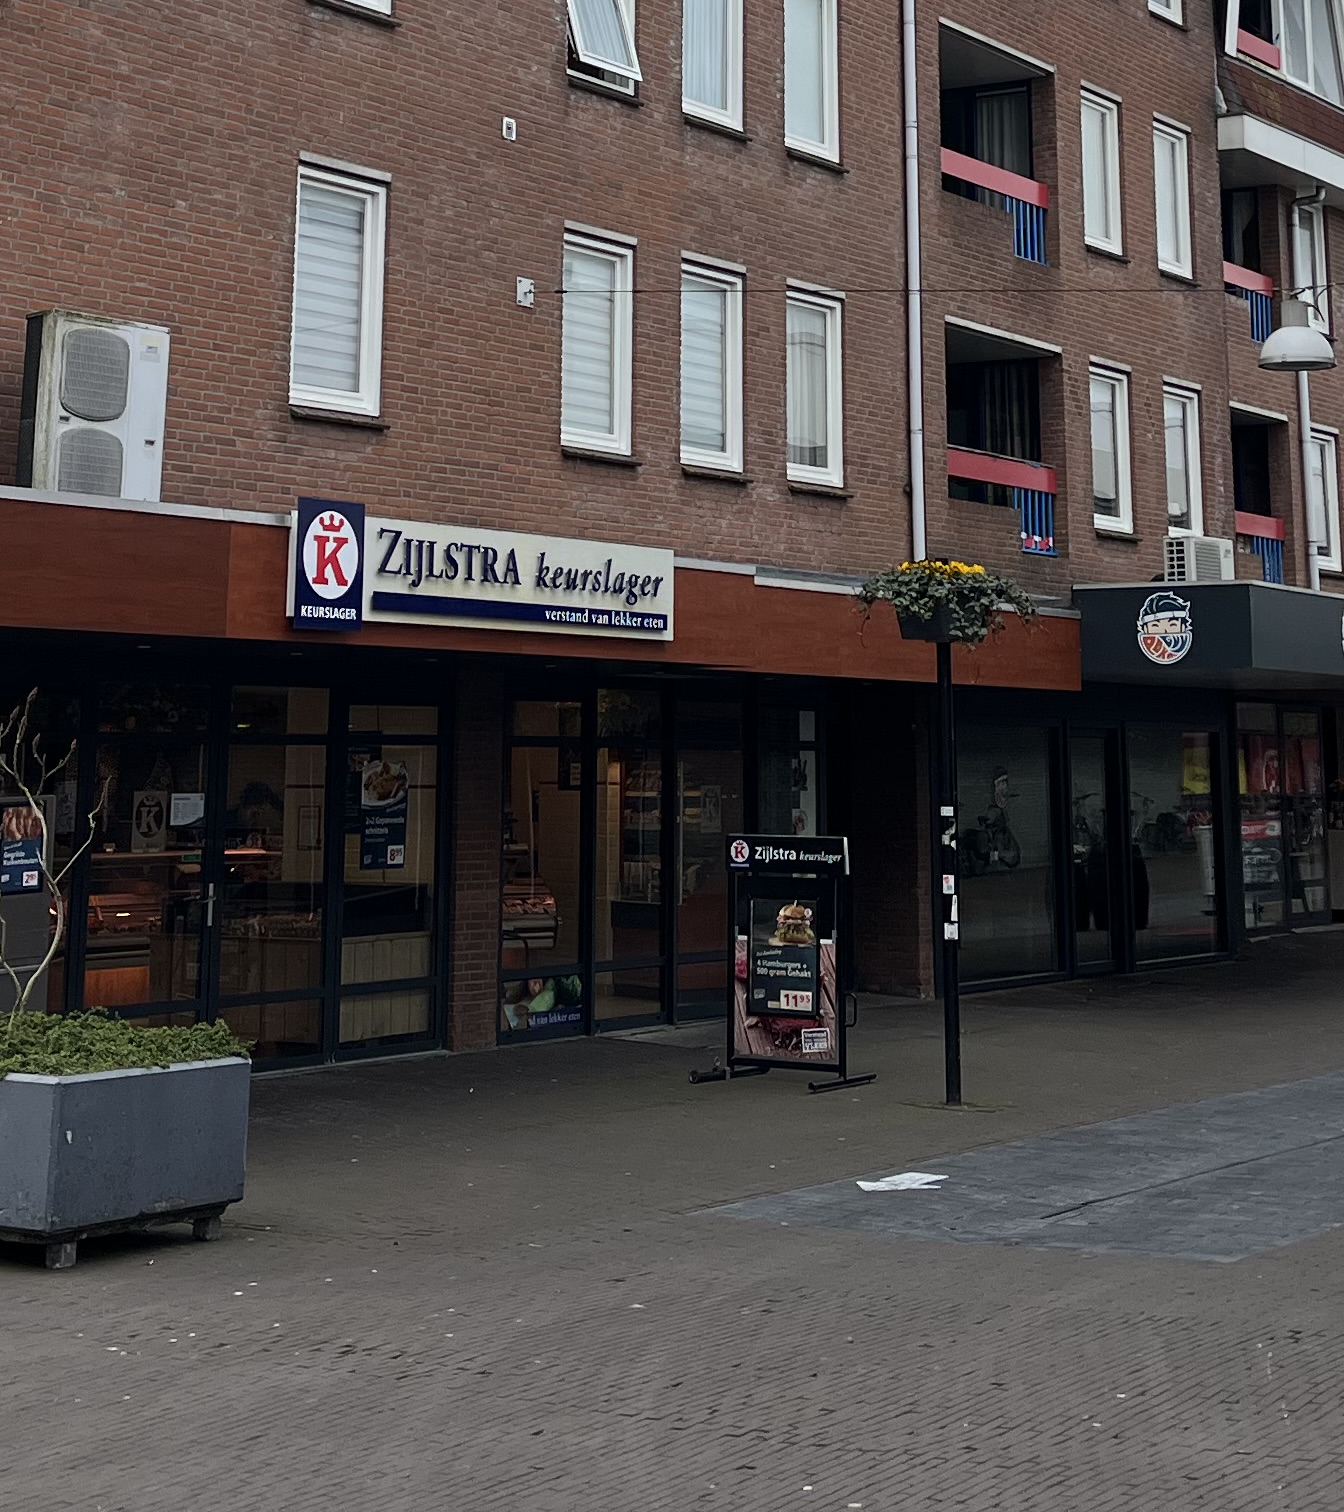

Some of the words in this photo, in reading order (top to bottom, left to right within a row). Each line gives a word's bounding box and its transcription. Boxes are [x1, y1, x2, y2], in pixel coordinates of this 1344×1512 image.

[312, 534, 350, 587] K
[378, 527, 522, 589] ZIJLSTRA
[536, 552, 664, 605] keurslager
[301, 605, 356, 620] KEURSLAGER
[545, 609, 589, 623] verstand
[592, 613, 609, 624] van
[612, 611, 641, 627] lekker
[644, 618, 664, 628] eten
[755, 846, 797, 863] Zijlstra
[799, 851, 842, 864] keurslager
